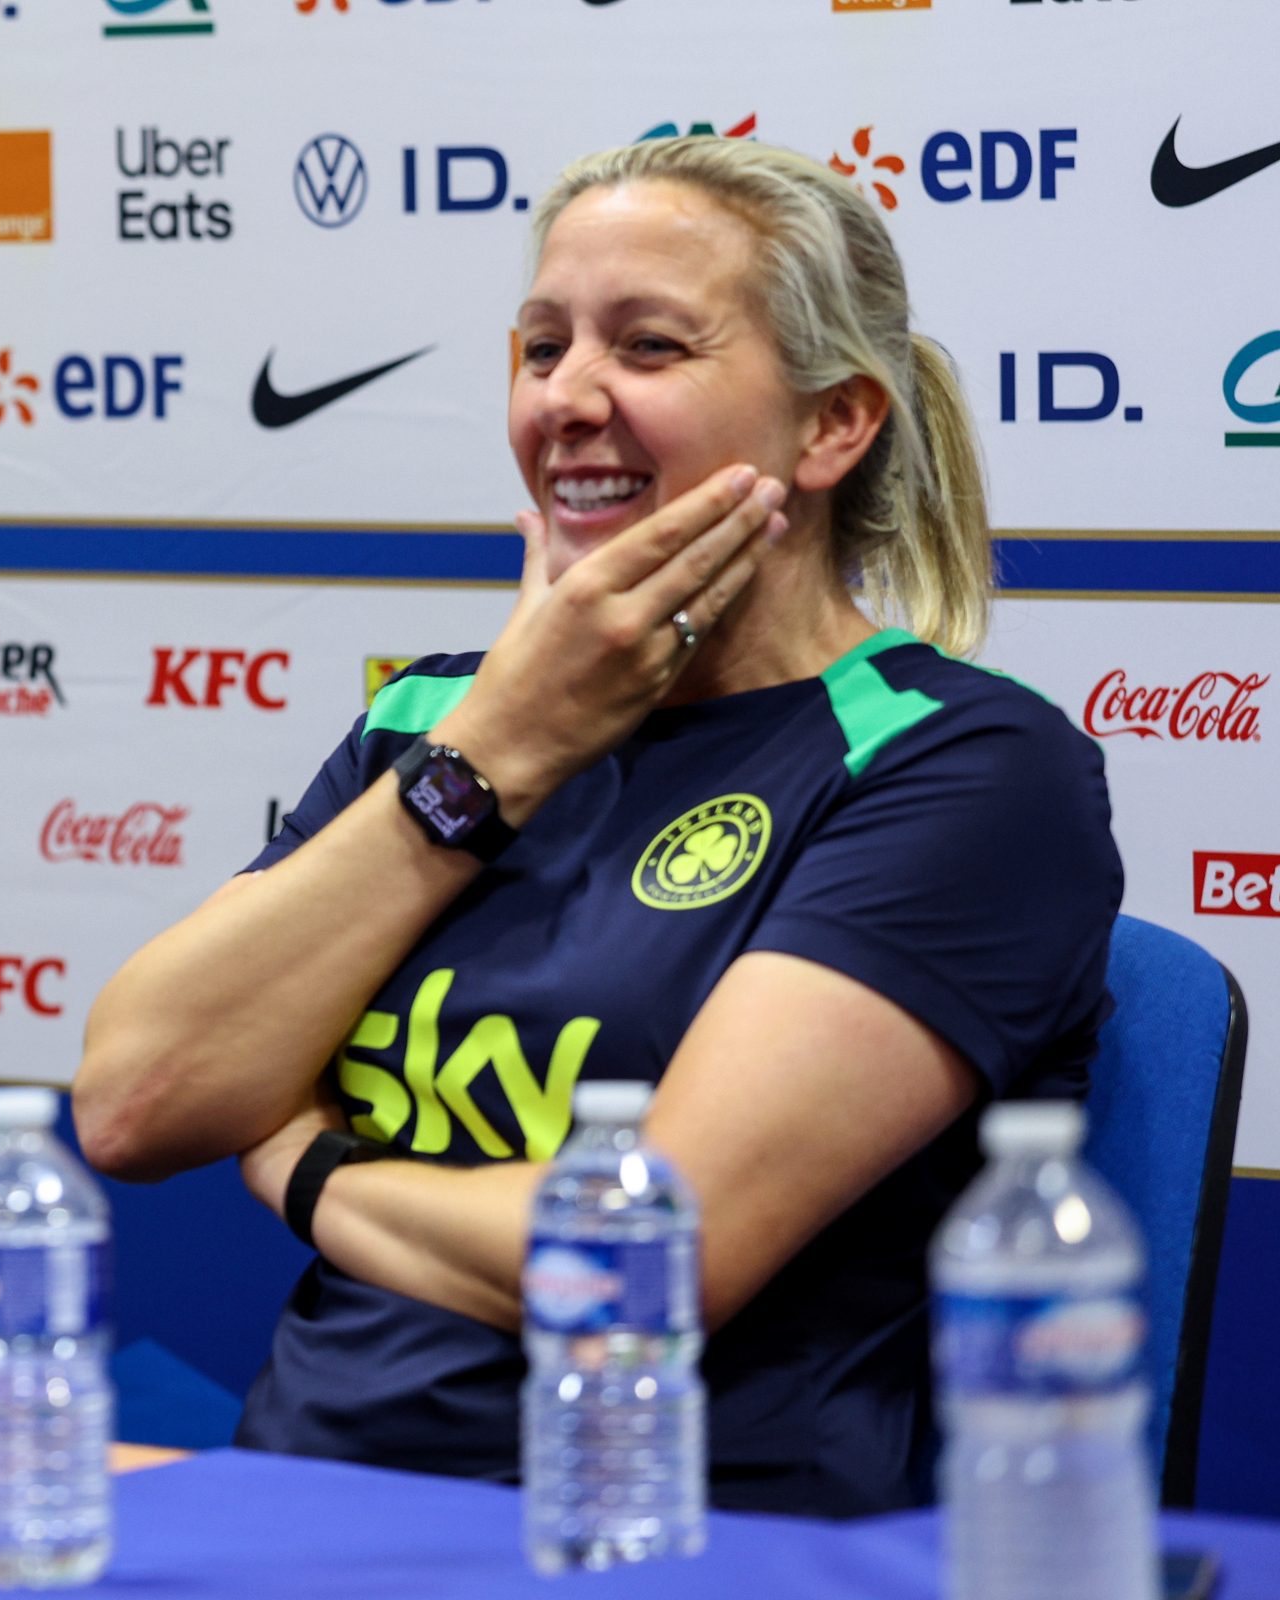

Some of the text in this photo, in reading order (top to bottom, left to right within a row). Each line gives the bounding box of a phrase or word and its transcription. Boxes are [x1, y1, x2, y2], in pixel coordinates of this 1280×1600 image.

[117, 128, 231, 178] Uber
[403, 146, 530, 214] ID.
[118, 190, 233, 241] Eats
[1000, 352, 1144, 423] ID.
[145, 647, 291, 711] KFC
[1083, 668, 1271, 742] Coca-Cola
[39, 799, 190, 867] Coca-Cola
[338, 967, 602, 1164] sky
